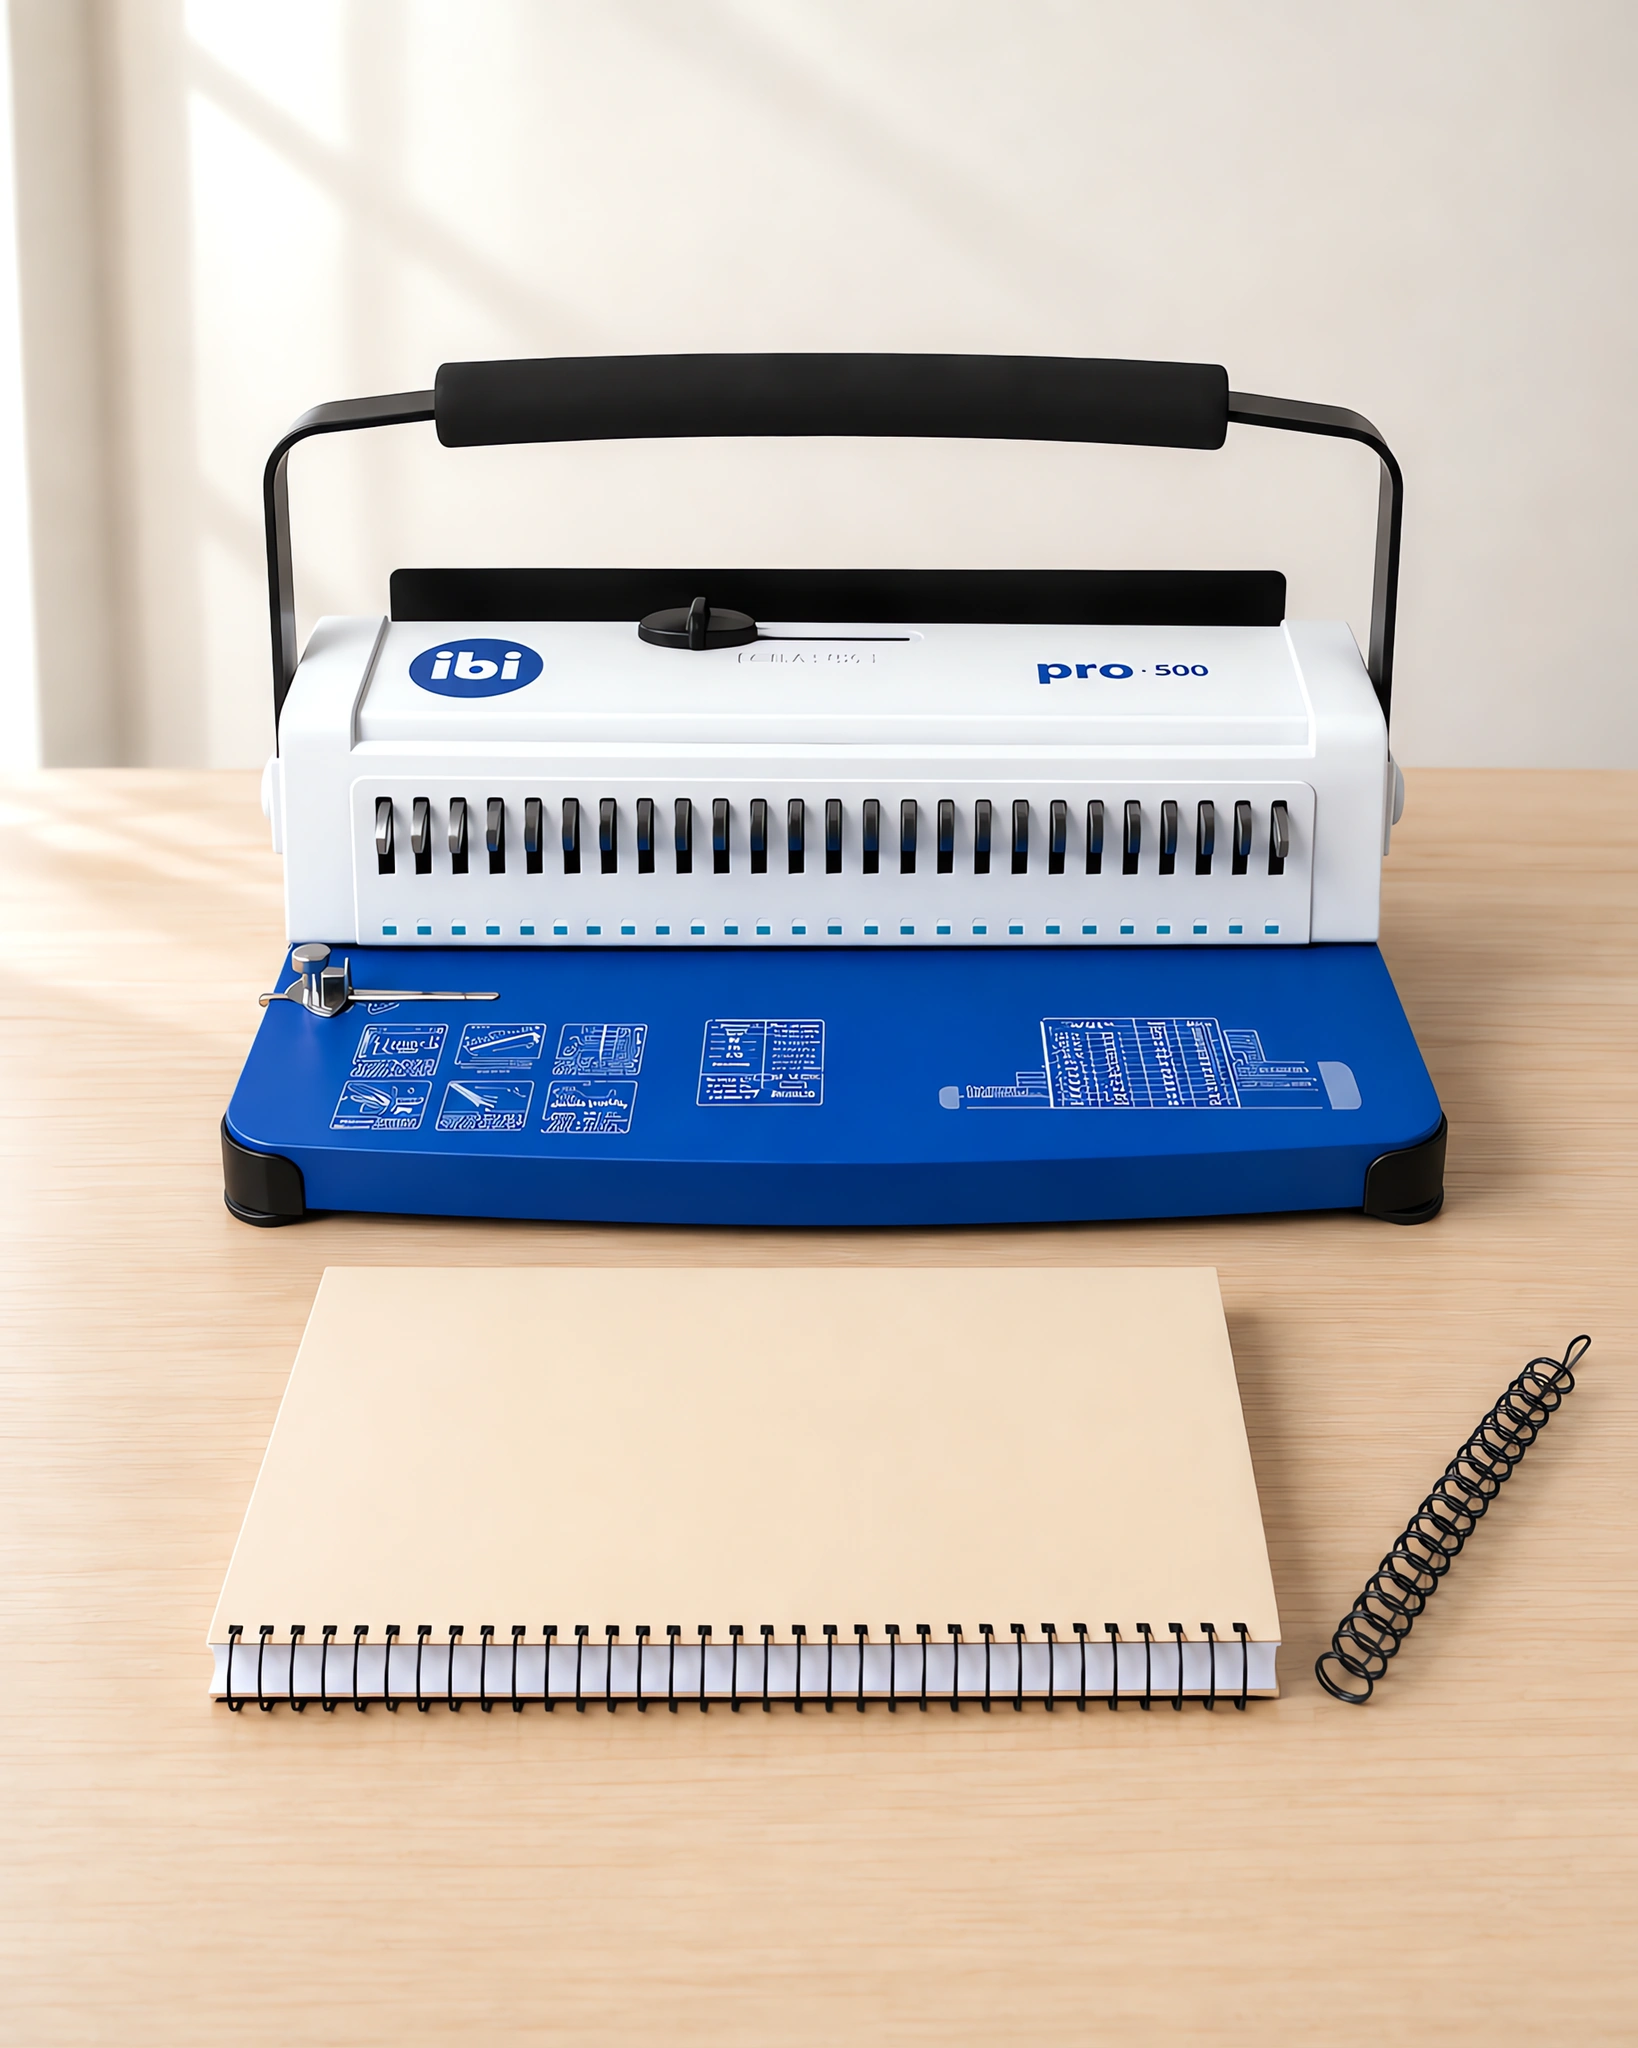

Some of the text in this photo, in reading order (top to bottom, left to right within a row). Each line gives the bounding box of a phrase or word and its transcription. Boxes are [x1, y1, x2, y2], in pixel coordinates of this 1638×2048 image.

[429, 650, 522, 681] ibi
[1037, 663, 1209, 684] pro 500
